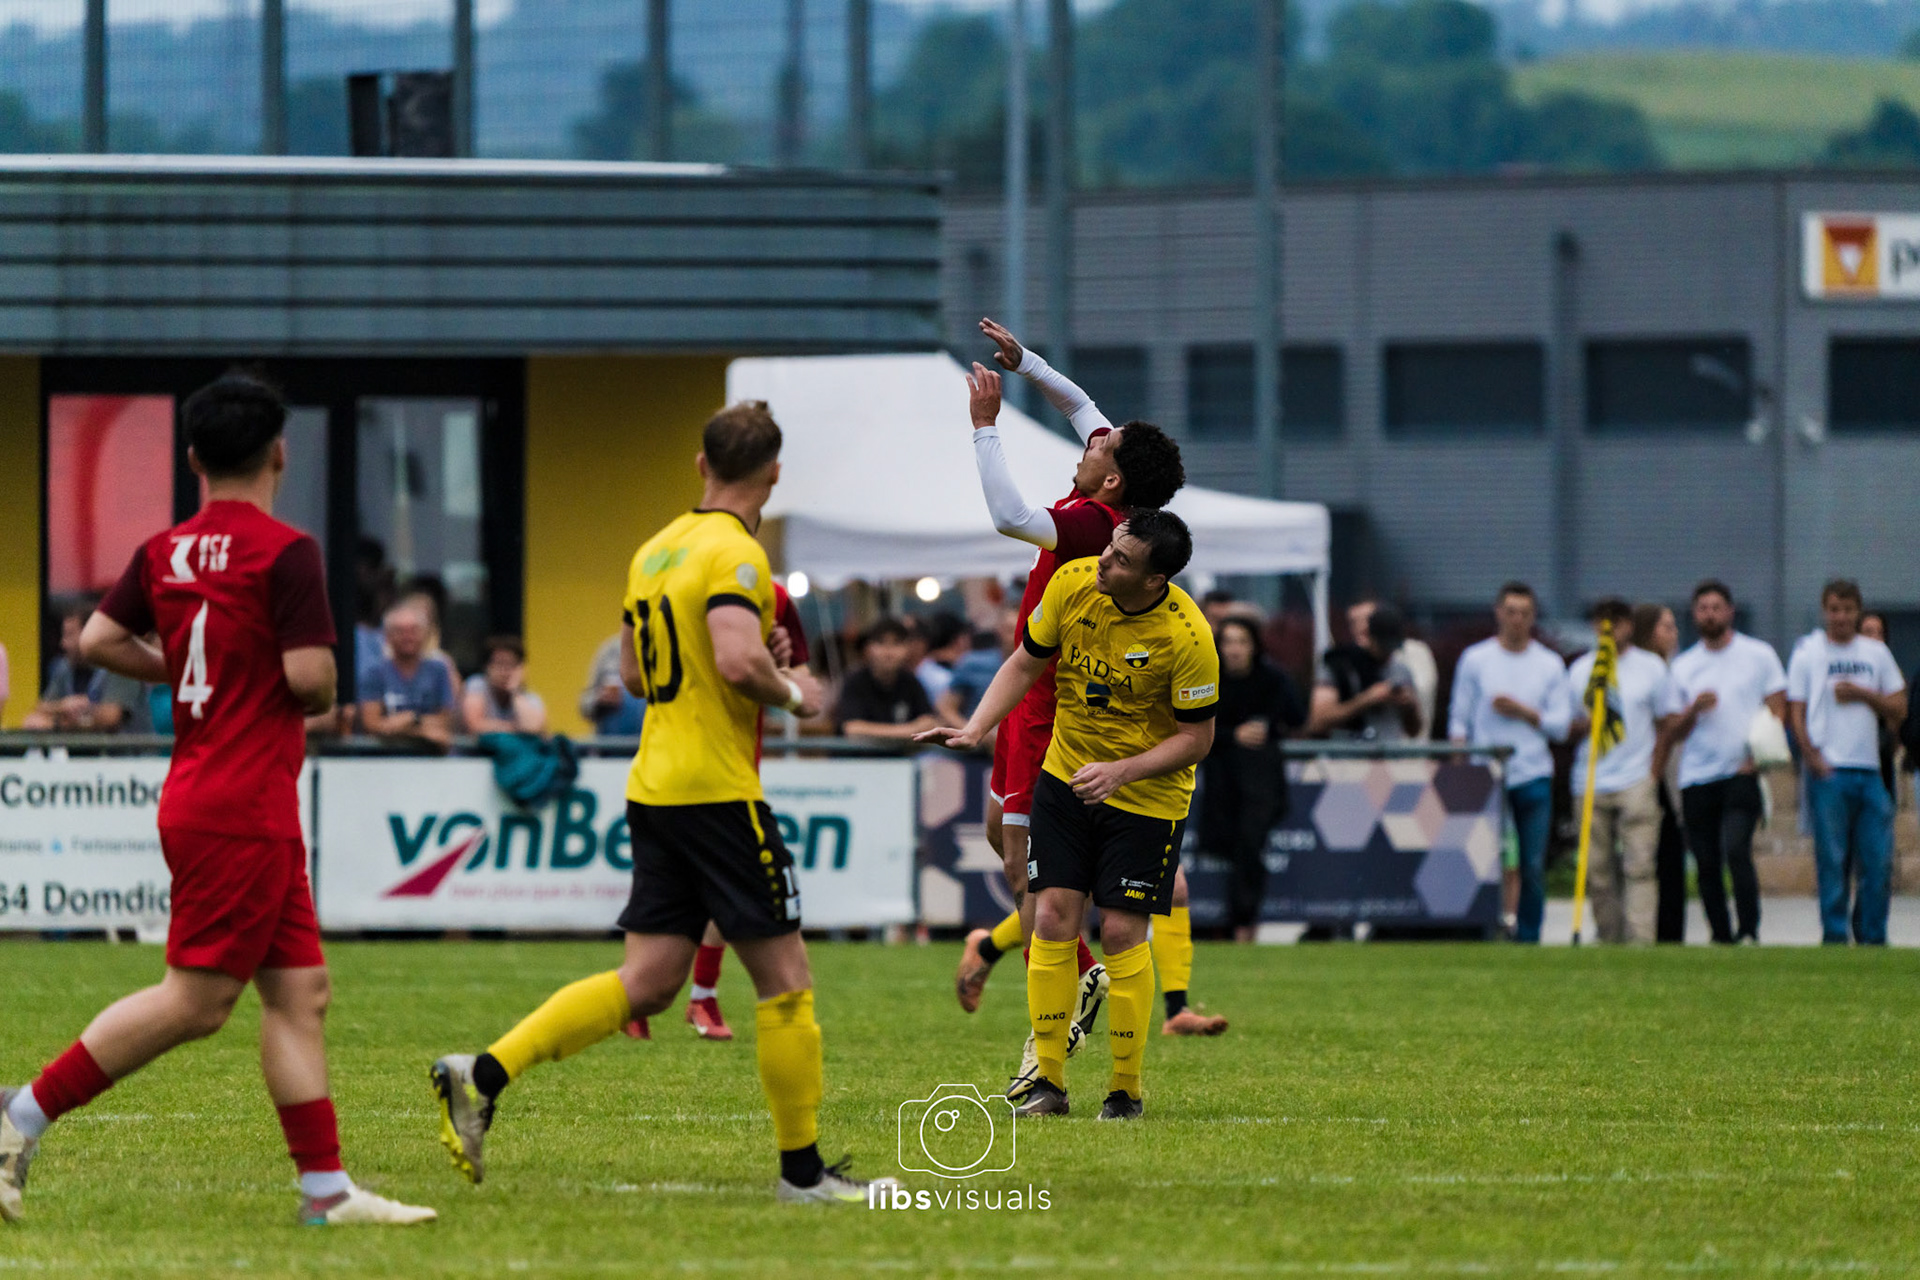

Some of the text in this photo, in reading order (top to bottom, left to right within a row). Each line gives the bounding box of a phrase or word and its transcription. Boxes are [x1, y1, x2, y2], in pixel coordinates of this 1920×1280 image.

[1076, 616, 1096, 630] JAKO
[177, 598, 214, 720] 4
[1124, 889, 1146, 900] JAKO
[1037, 1012, 1066, 1021] JAKO
[1110, 1030, 1134, 1039] JAKO
